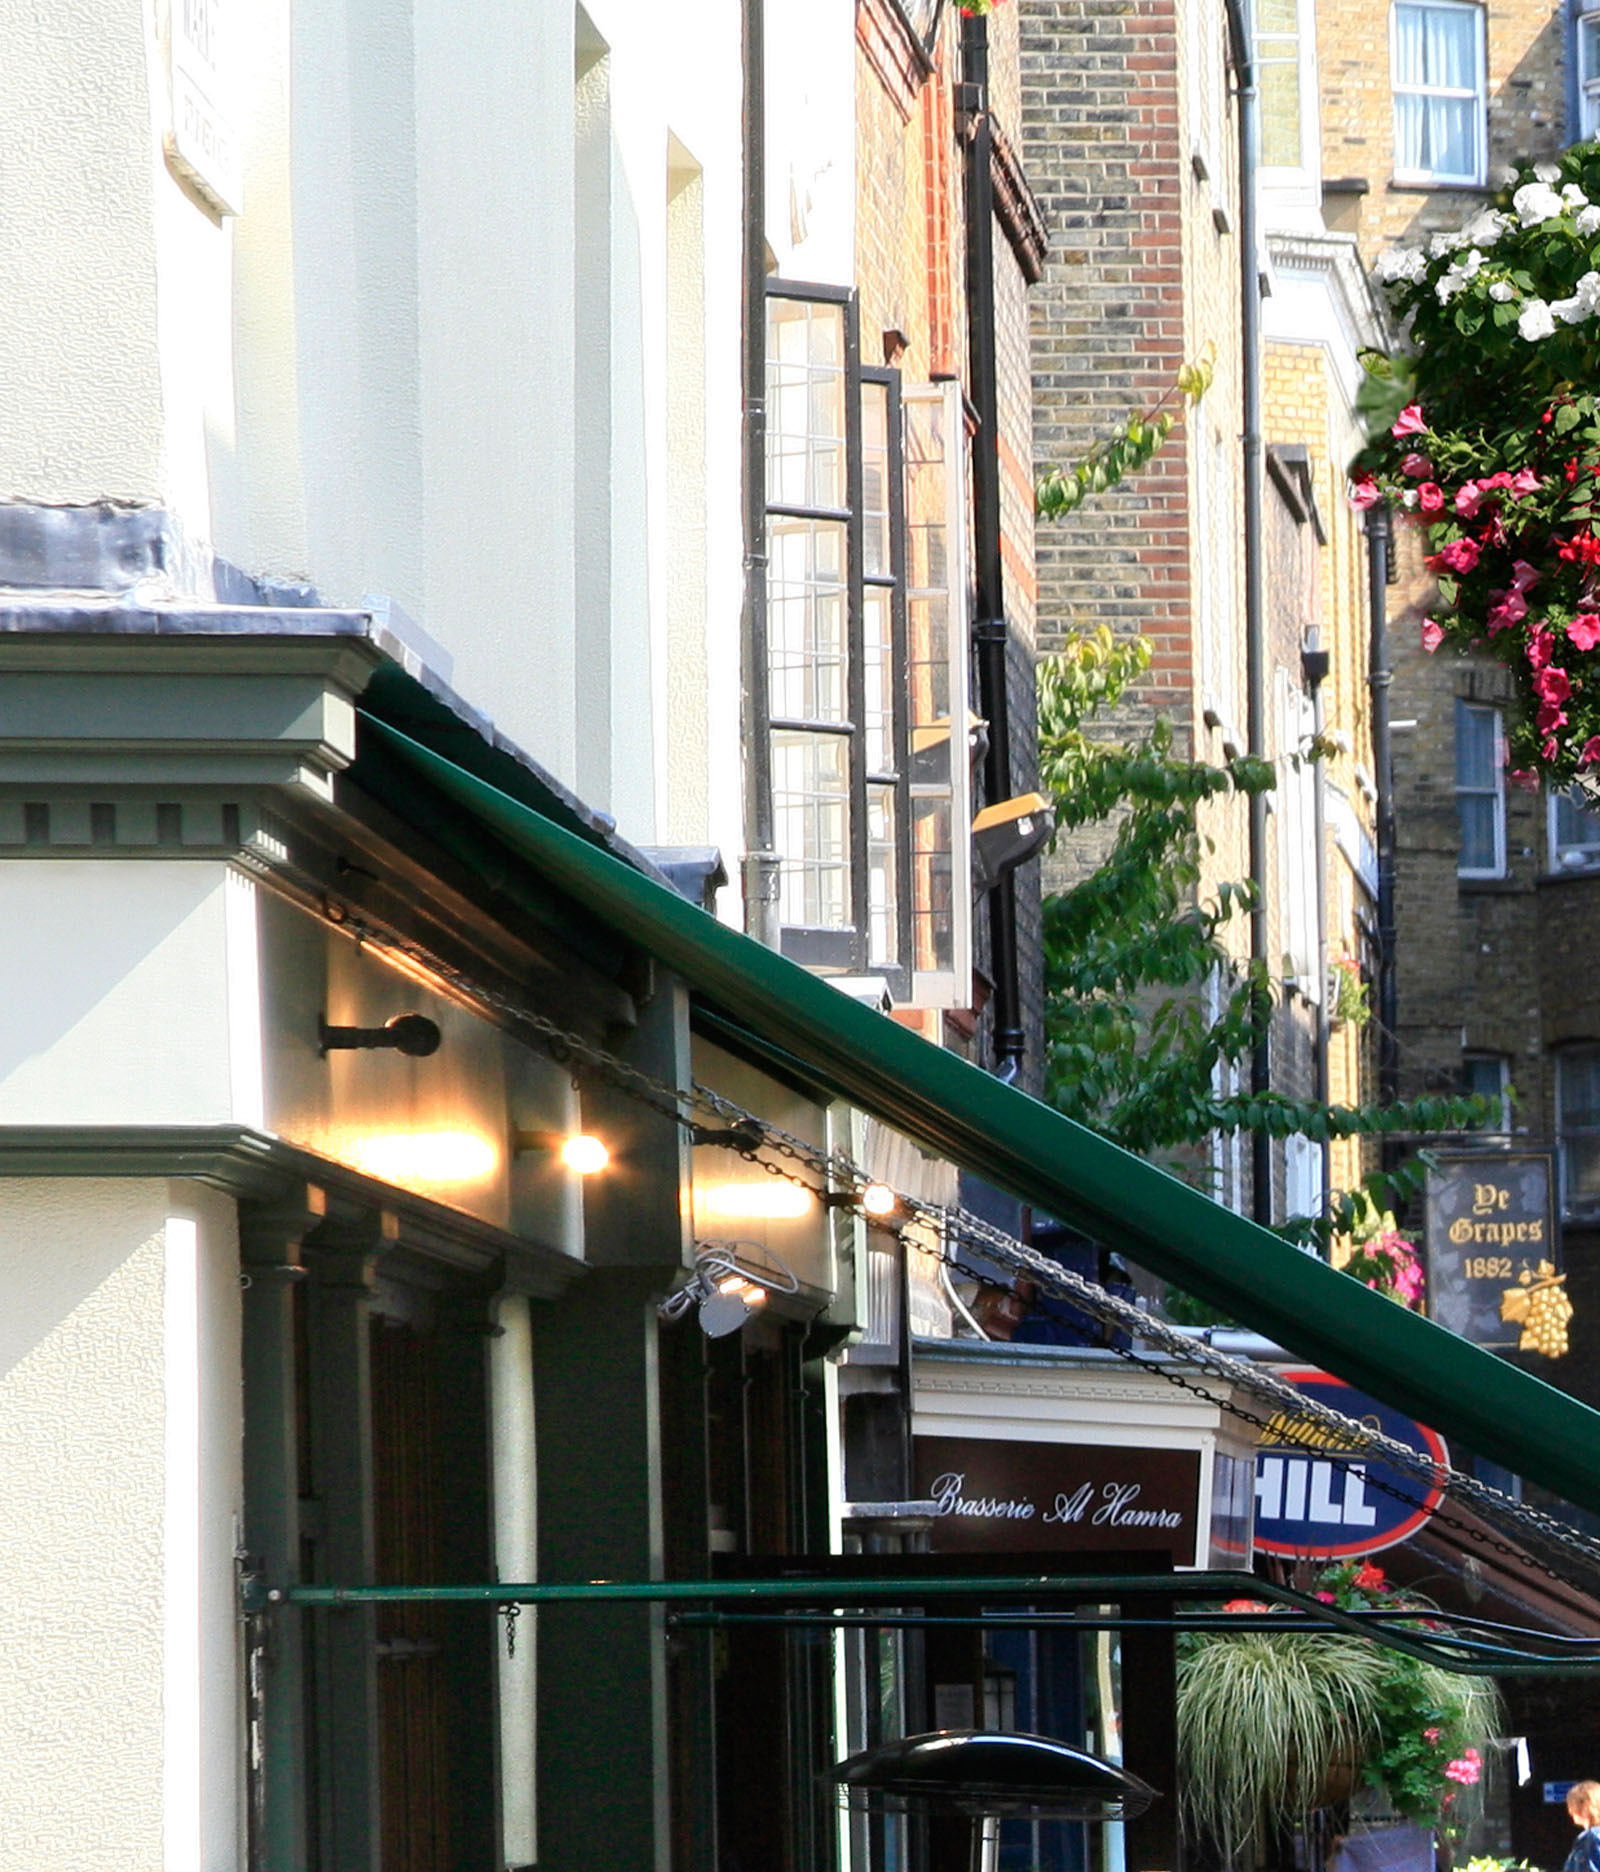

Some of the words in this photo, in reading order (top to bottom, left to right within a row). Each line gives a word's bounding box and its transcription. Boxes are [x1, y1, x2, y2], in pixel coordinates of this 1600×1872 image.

[1472, 1184, 1511, 1215] Ye
[1448, 1218, 1543, 1247] Grapes
[1464, 1257, 1513, 1279] 1882
[930, 1473, 1036, 1518] Brasserie
[1092, 1482, 1183, 1528] Hamra
[1254, 1457, 1376, 1526] HILL
